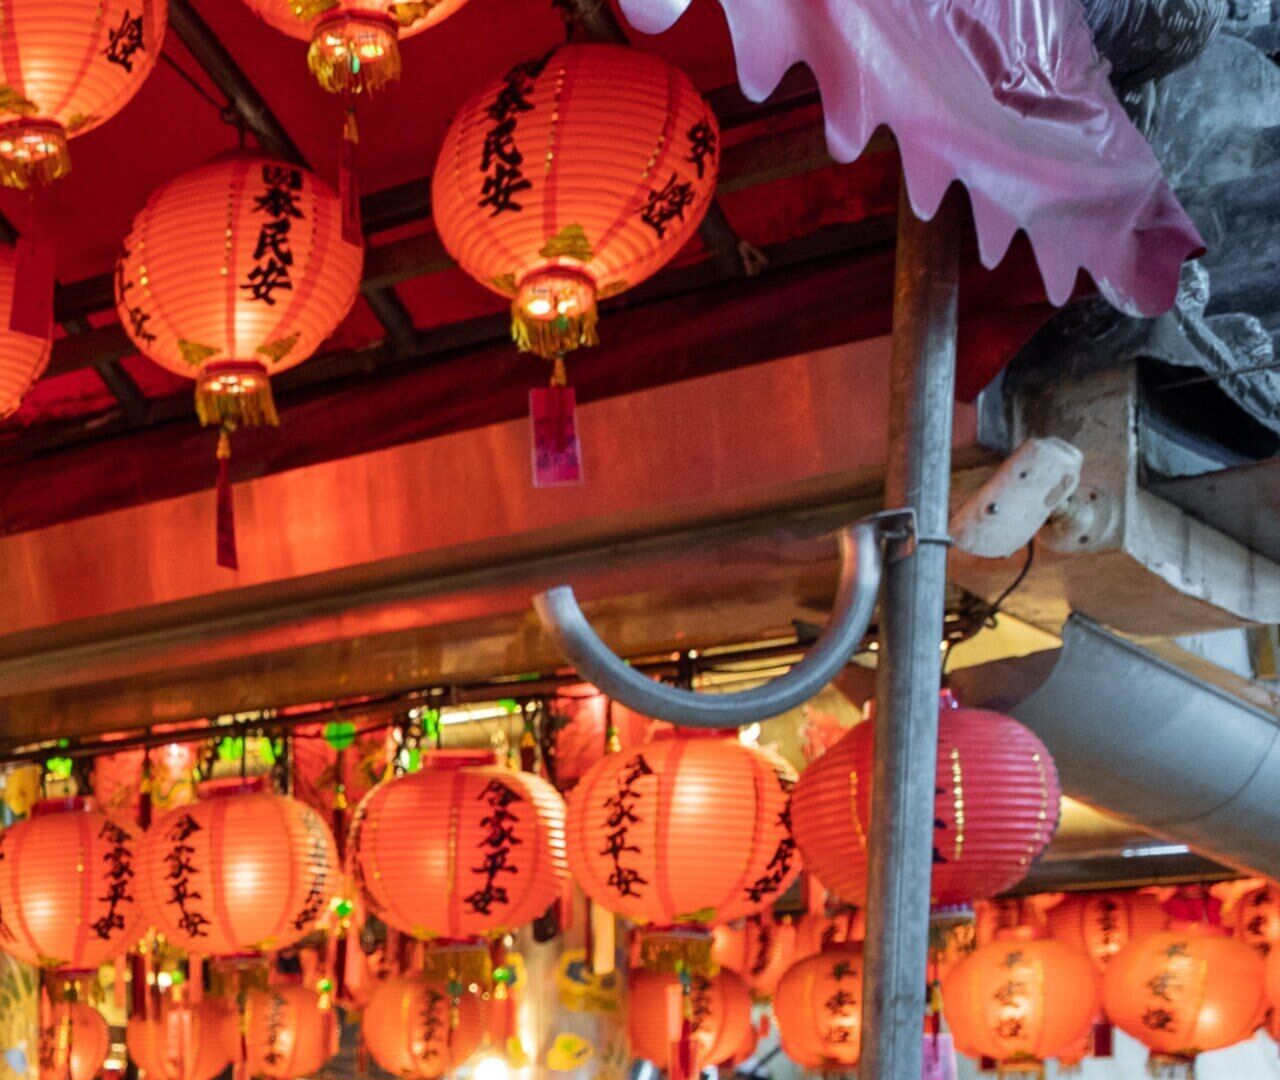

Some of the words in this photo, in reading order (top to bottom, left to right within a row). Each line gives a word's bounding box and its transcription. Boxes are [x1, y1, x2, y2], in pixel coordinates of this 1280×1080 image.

[464, 780, 523, 916] 合家平安
[599, 754, 654, 899] 合家平安
